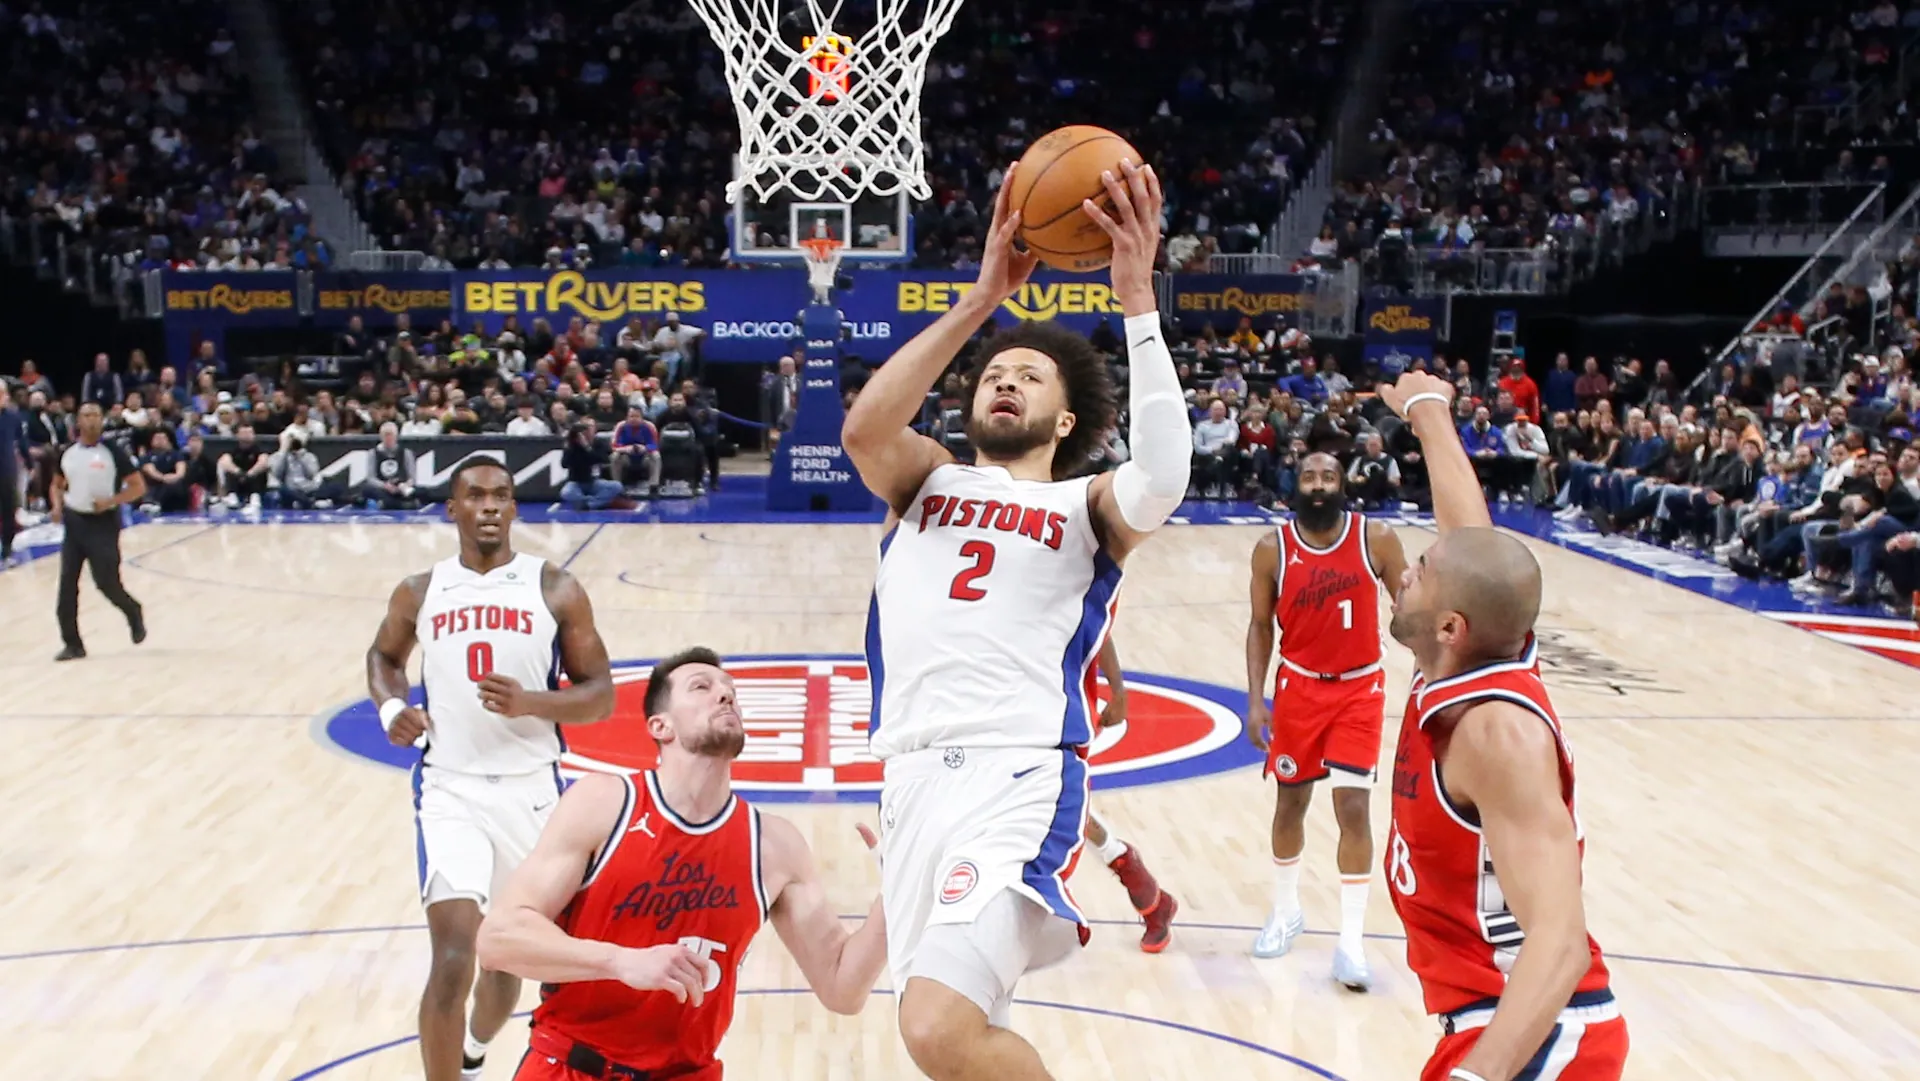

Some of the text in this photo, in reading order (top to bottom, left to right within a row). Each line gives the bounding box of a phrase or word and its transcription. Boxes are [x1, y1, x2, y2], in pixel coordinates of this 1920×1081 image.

[465, 270, 705, 321] BETRIVERS
[897, 282, 1124, 321] BETIVER
[790, 446, 842, 457] HENRY
[791, 458, 831, 469] FORD
[791, 471, 850, 482] HEALTH
[918, 494, 1068, 551] PISTONS
[949, 540, 996, 602] 2
[1309, 565, 1337, 588] Los
[1294, 571, 1361, 612] Angeles
[431, 604, 534, 641] PISTONS
[1337, 599, 1353, 630] 1
[467, 641, 494, 683] 0
[657, 851, 709, 887] Los
[612, 874, 739, 931] Angeles
